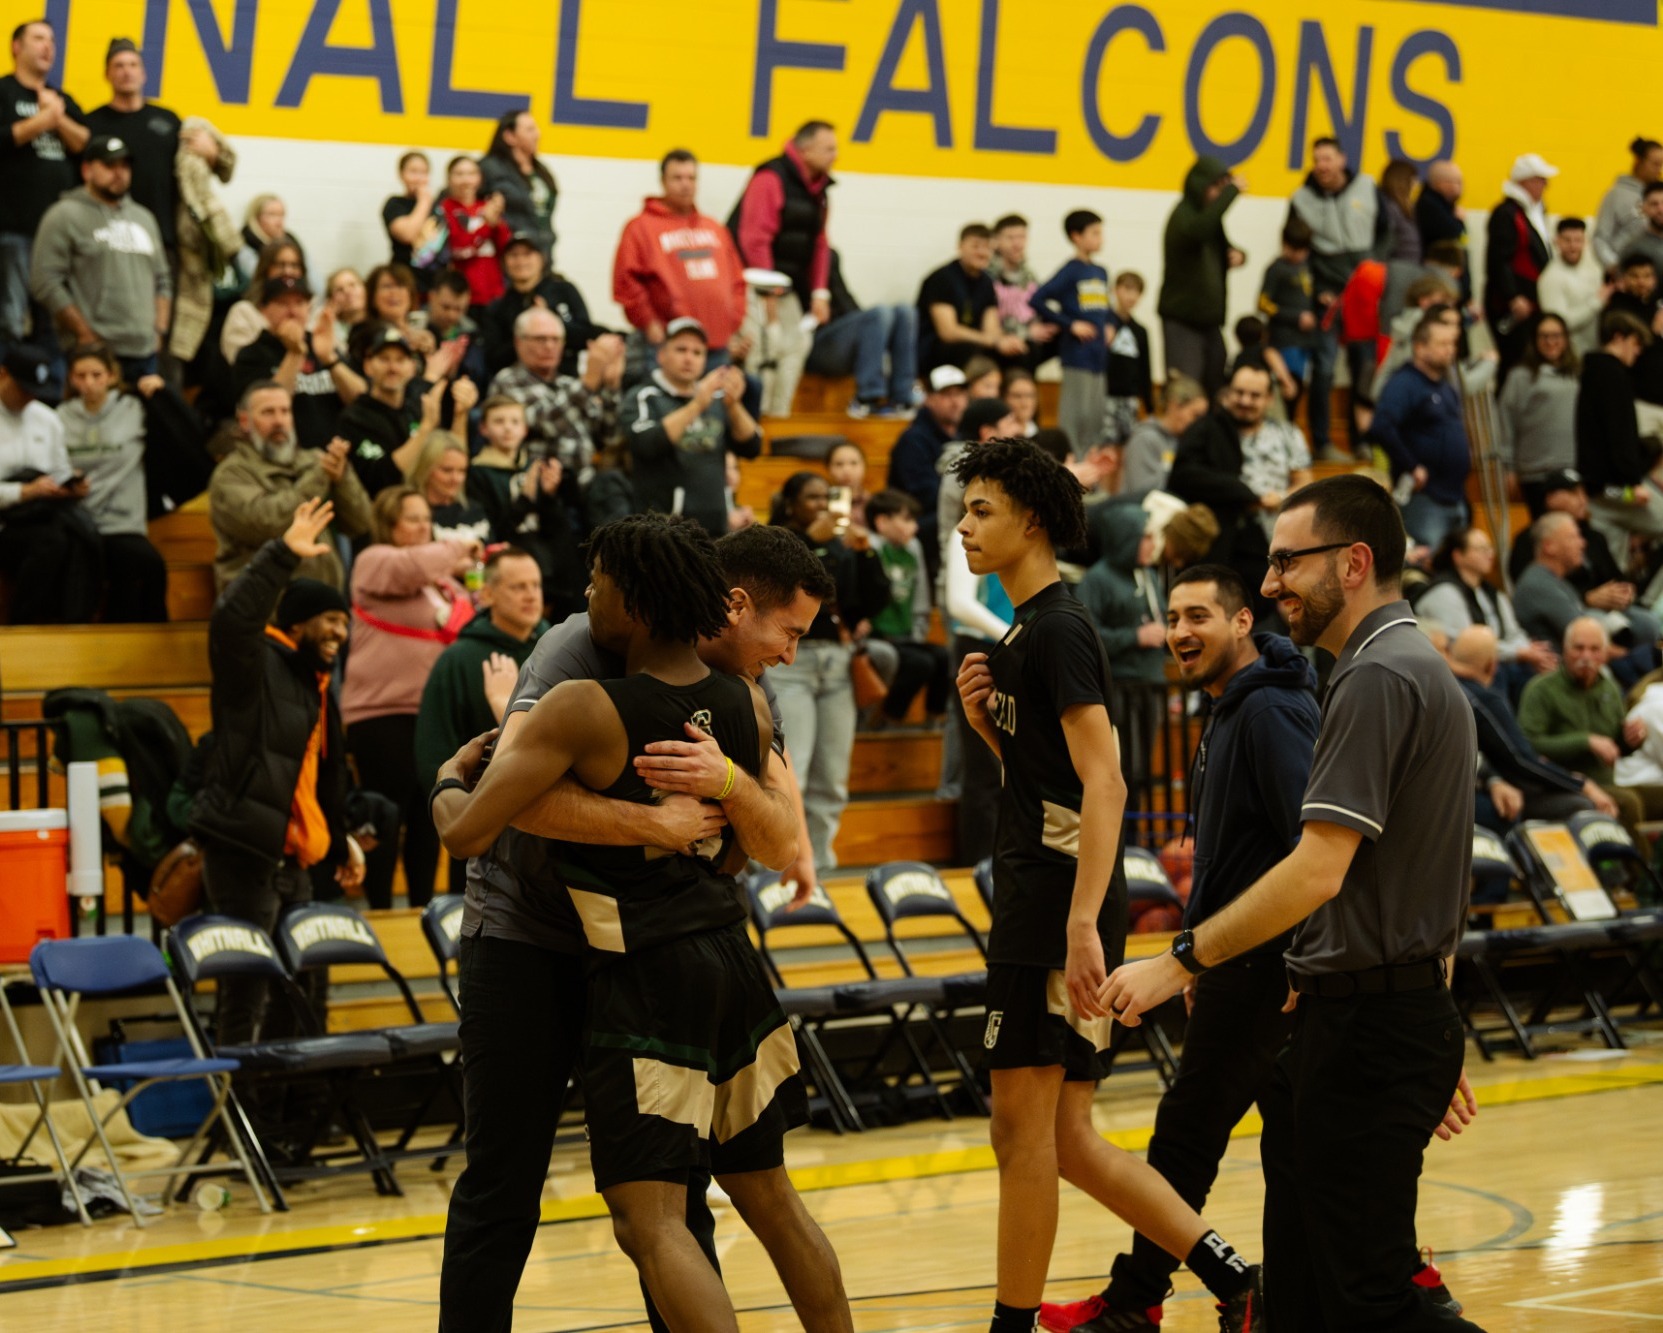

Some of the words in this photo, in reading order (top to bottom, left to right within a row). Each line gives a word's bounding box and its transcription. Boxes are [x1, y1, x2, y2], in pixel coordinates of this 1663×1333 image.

[750, 0, 1463, 181] FALCONS
[187, 926, 273, 962] WHITNALL
[290, 915, 375, 952] WHITNALL
